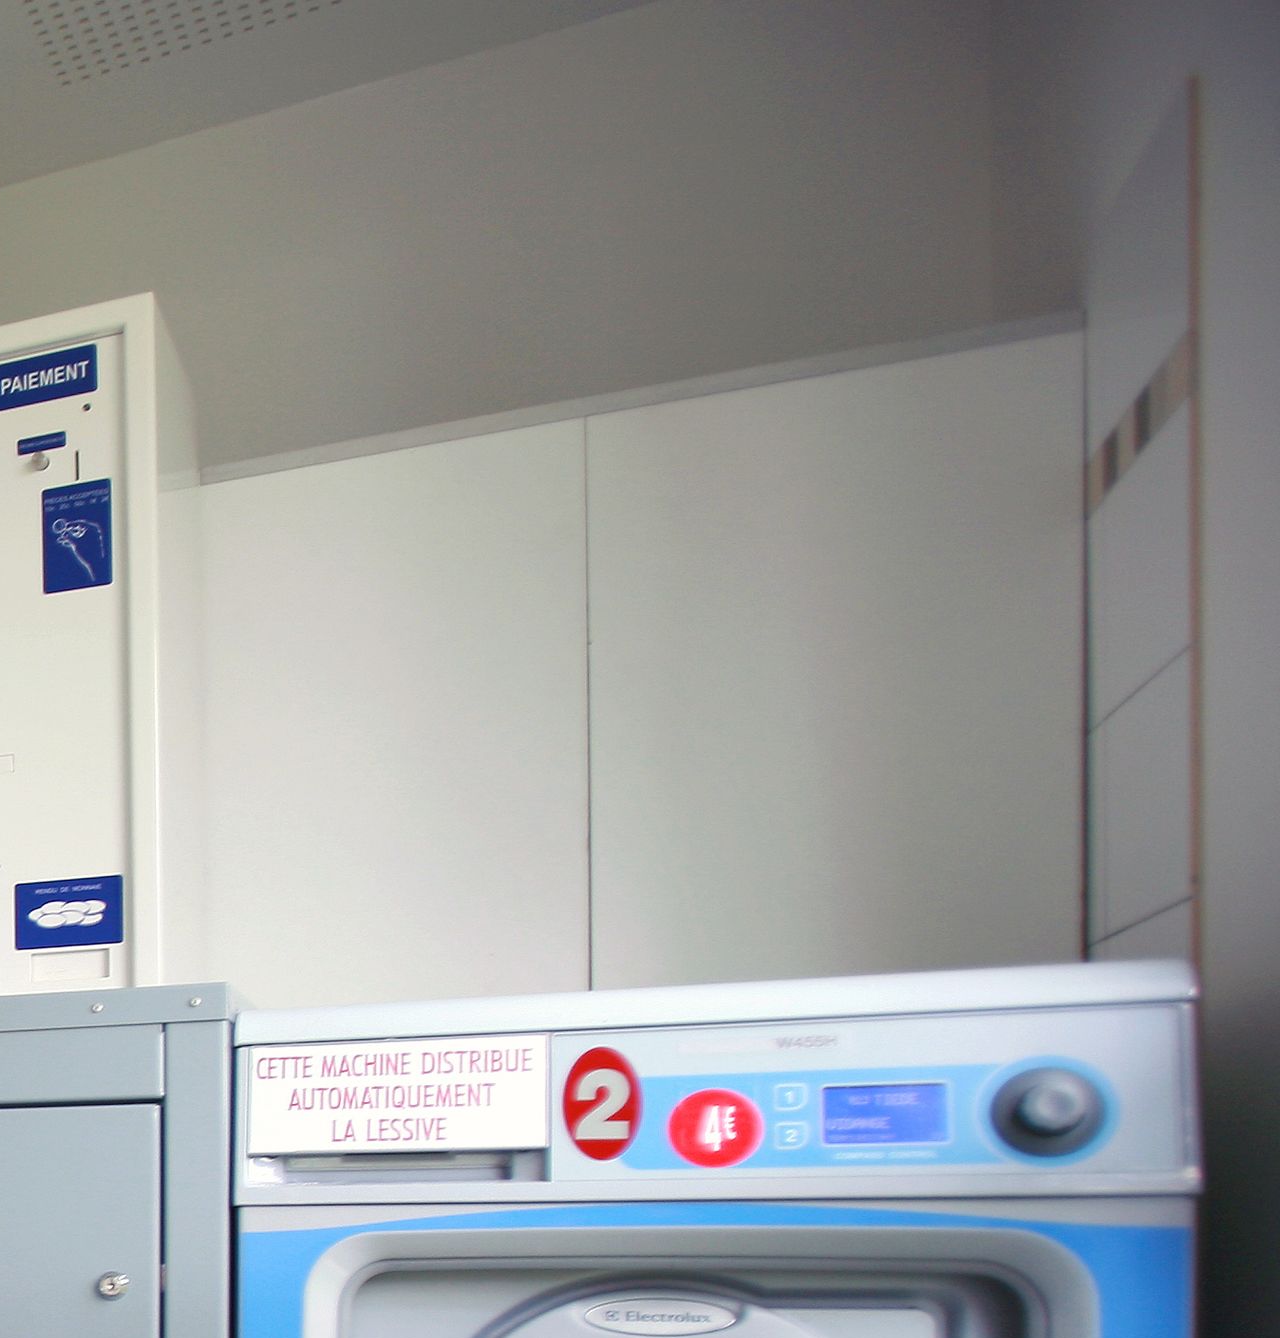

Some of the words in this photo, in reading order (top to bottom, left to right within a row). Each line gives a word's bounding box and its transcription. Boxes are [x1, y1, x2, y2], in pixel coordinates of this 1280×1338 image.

[0, 359, 91, 396] PAIEMENT
[255, 1055, 314, 1081] CETTE
[320, 1052, 412, 1079] MACHINE
[420, 1047, 534, 1076] DISTRIBUE
[287, 1081, 497, 1112] AUTOMATIQUEMENT
[574, 1067, 632, 1142] 2
[784, 1090, 794, 1104] 1
[330, 1119, 357, 1144] LA
[365, 1116, 449, 1143] LESSIVE
[702, 1104, 738, 1153] 4€
[784, 1129, 799, 1144] 2
[625, 1310, 711, 1324] Electrolux
